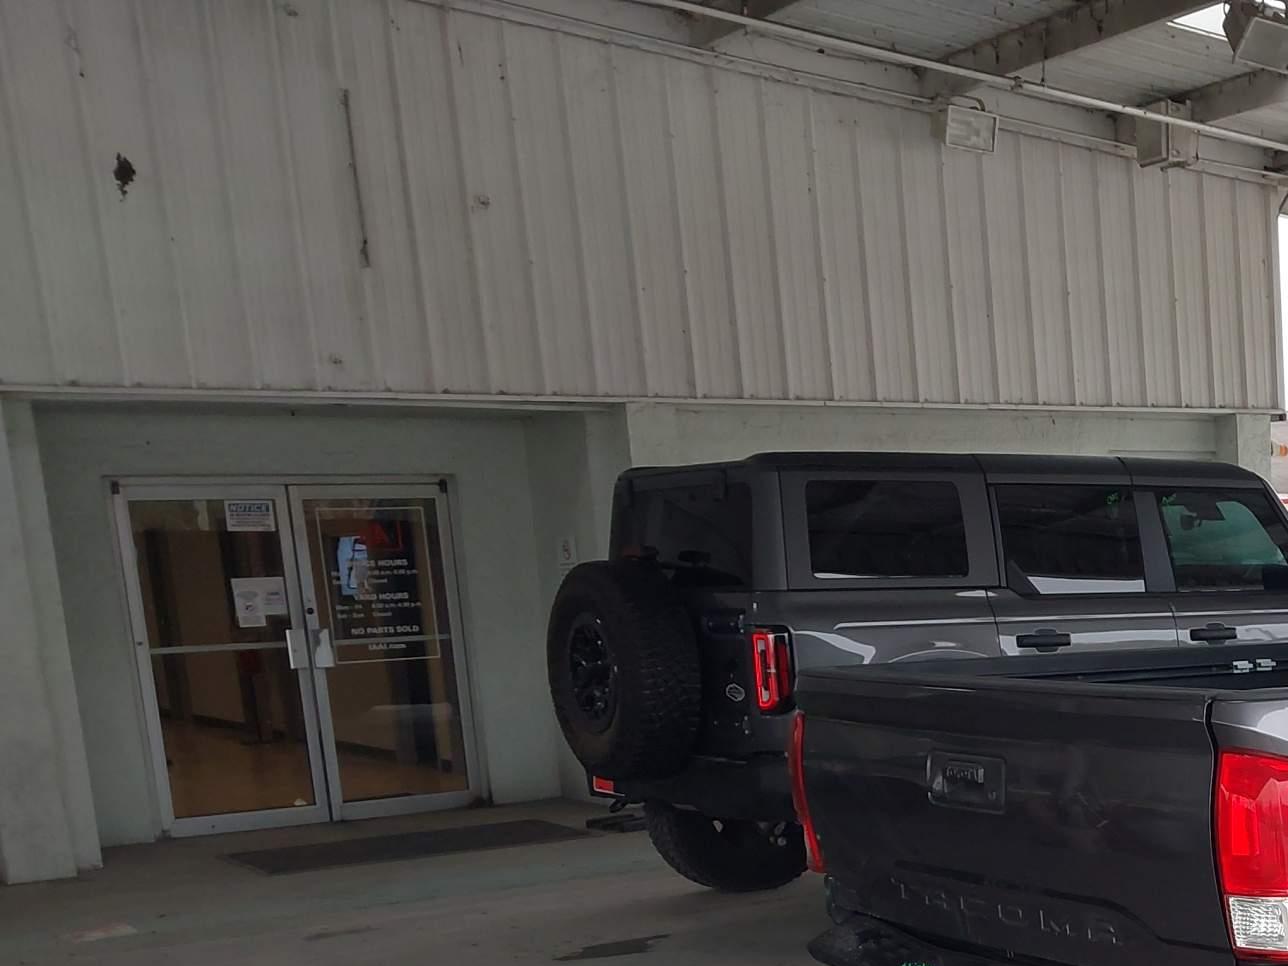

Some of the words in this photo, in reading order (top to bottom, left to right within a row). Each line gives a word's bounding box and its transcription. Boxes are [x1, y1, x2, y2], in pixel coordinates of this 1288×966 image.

[229, 503, 268, 512] NOTICE
[378, 558, 408, 567] HOURS
[379, 592, 409, 600] HOURS
[367, 626, 395, 634] PARTS
[397, 625, 420, 633] SOLD
[889, 875, 1123, 945] TACOMA
